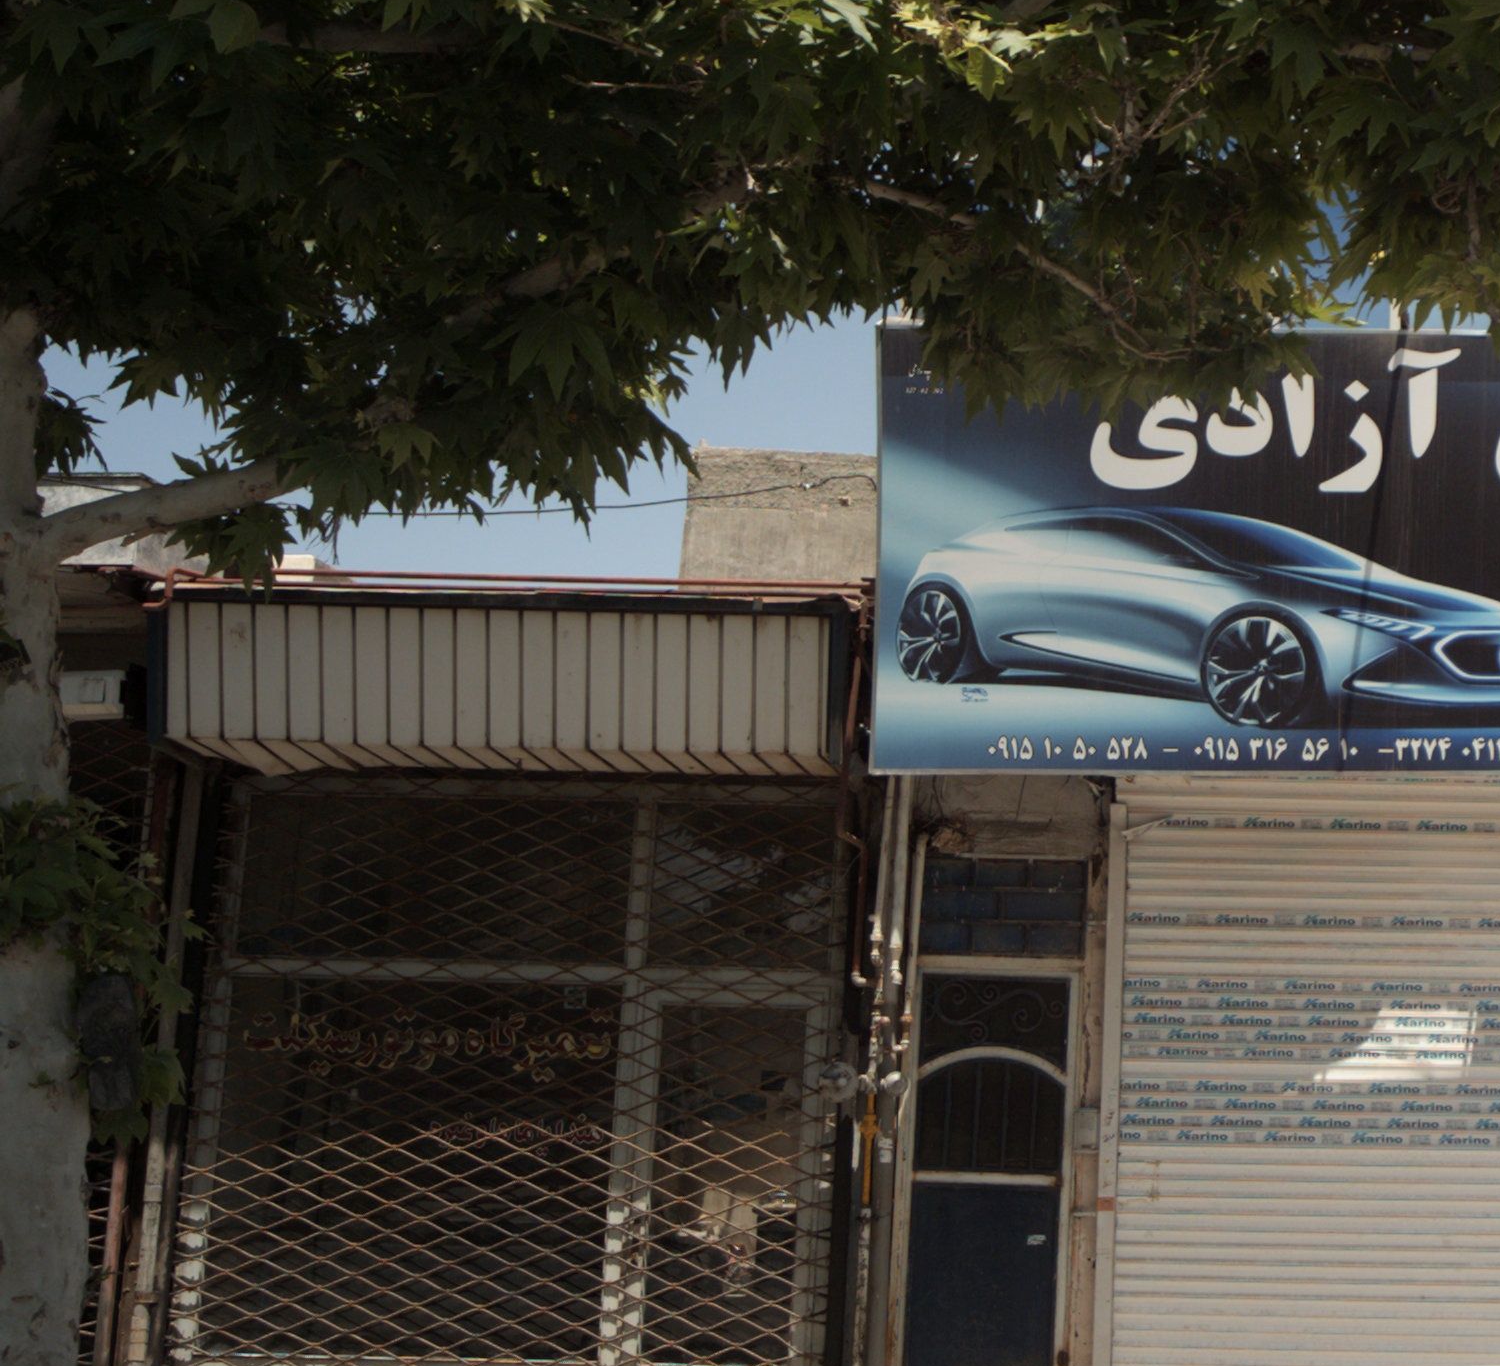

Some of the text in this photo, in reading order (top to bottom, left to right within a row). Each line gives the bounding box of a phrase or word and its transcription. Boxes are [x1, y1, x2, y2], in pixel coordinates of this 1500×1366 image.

[1089, 347, 1461, 494] آزادی
[987, 735, 1034, 760] ۰۹۱۵
[1043, 736, 1062, 760] ۱۰
[1072, 736, 1097, 760] ۵۰
[1106, 736, 1149, 761] ۵۲۸
[1193, 736, 1239, 762] ۰۹۱۵
[1249, 737, 1287, 762] ۳۱۶
[1300, 737, 1331, 762] ۵۶
[1340, 737, 1359, 762] ۱۰
